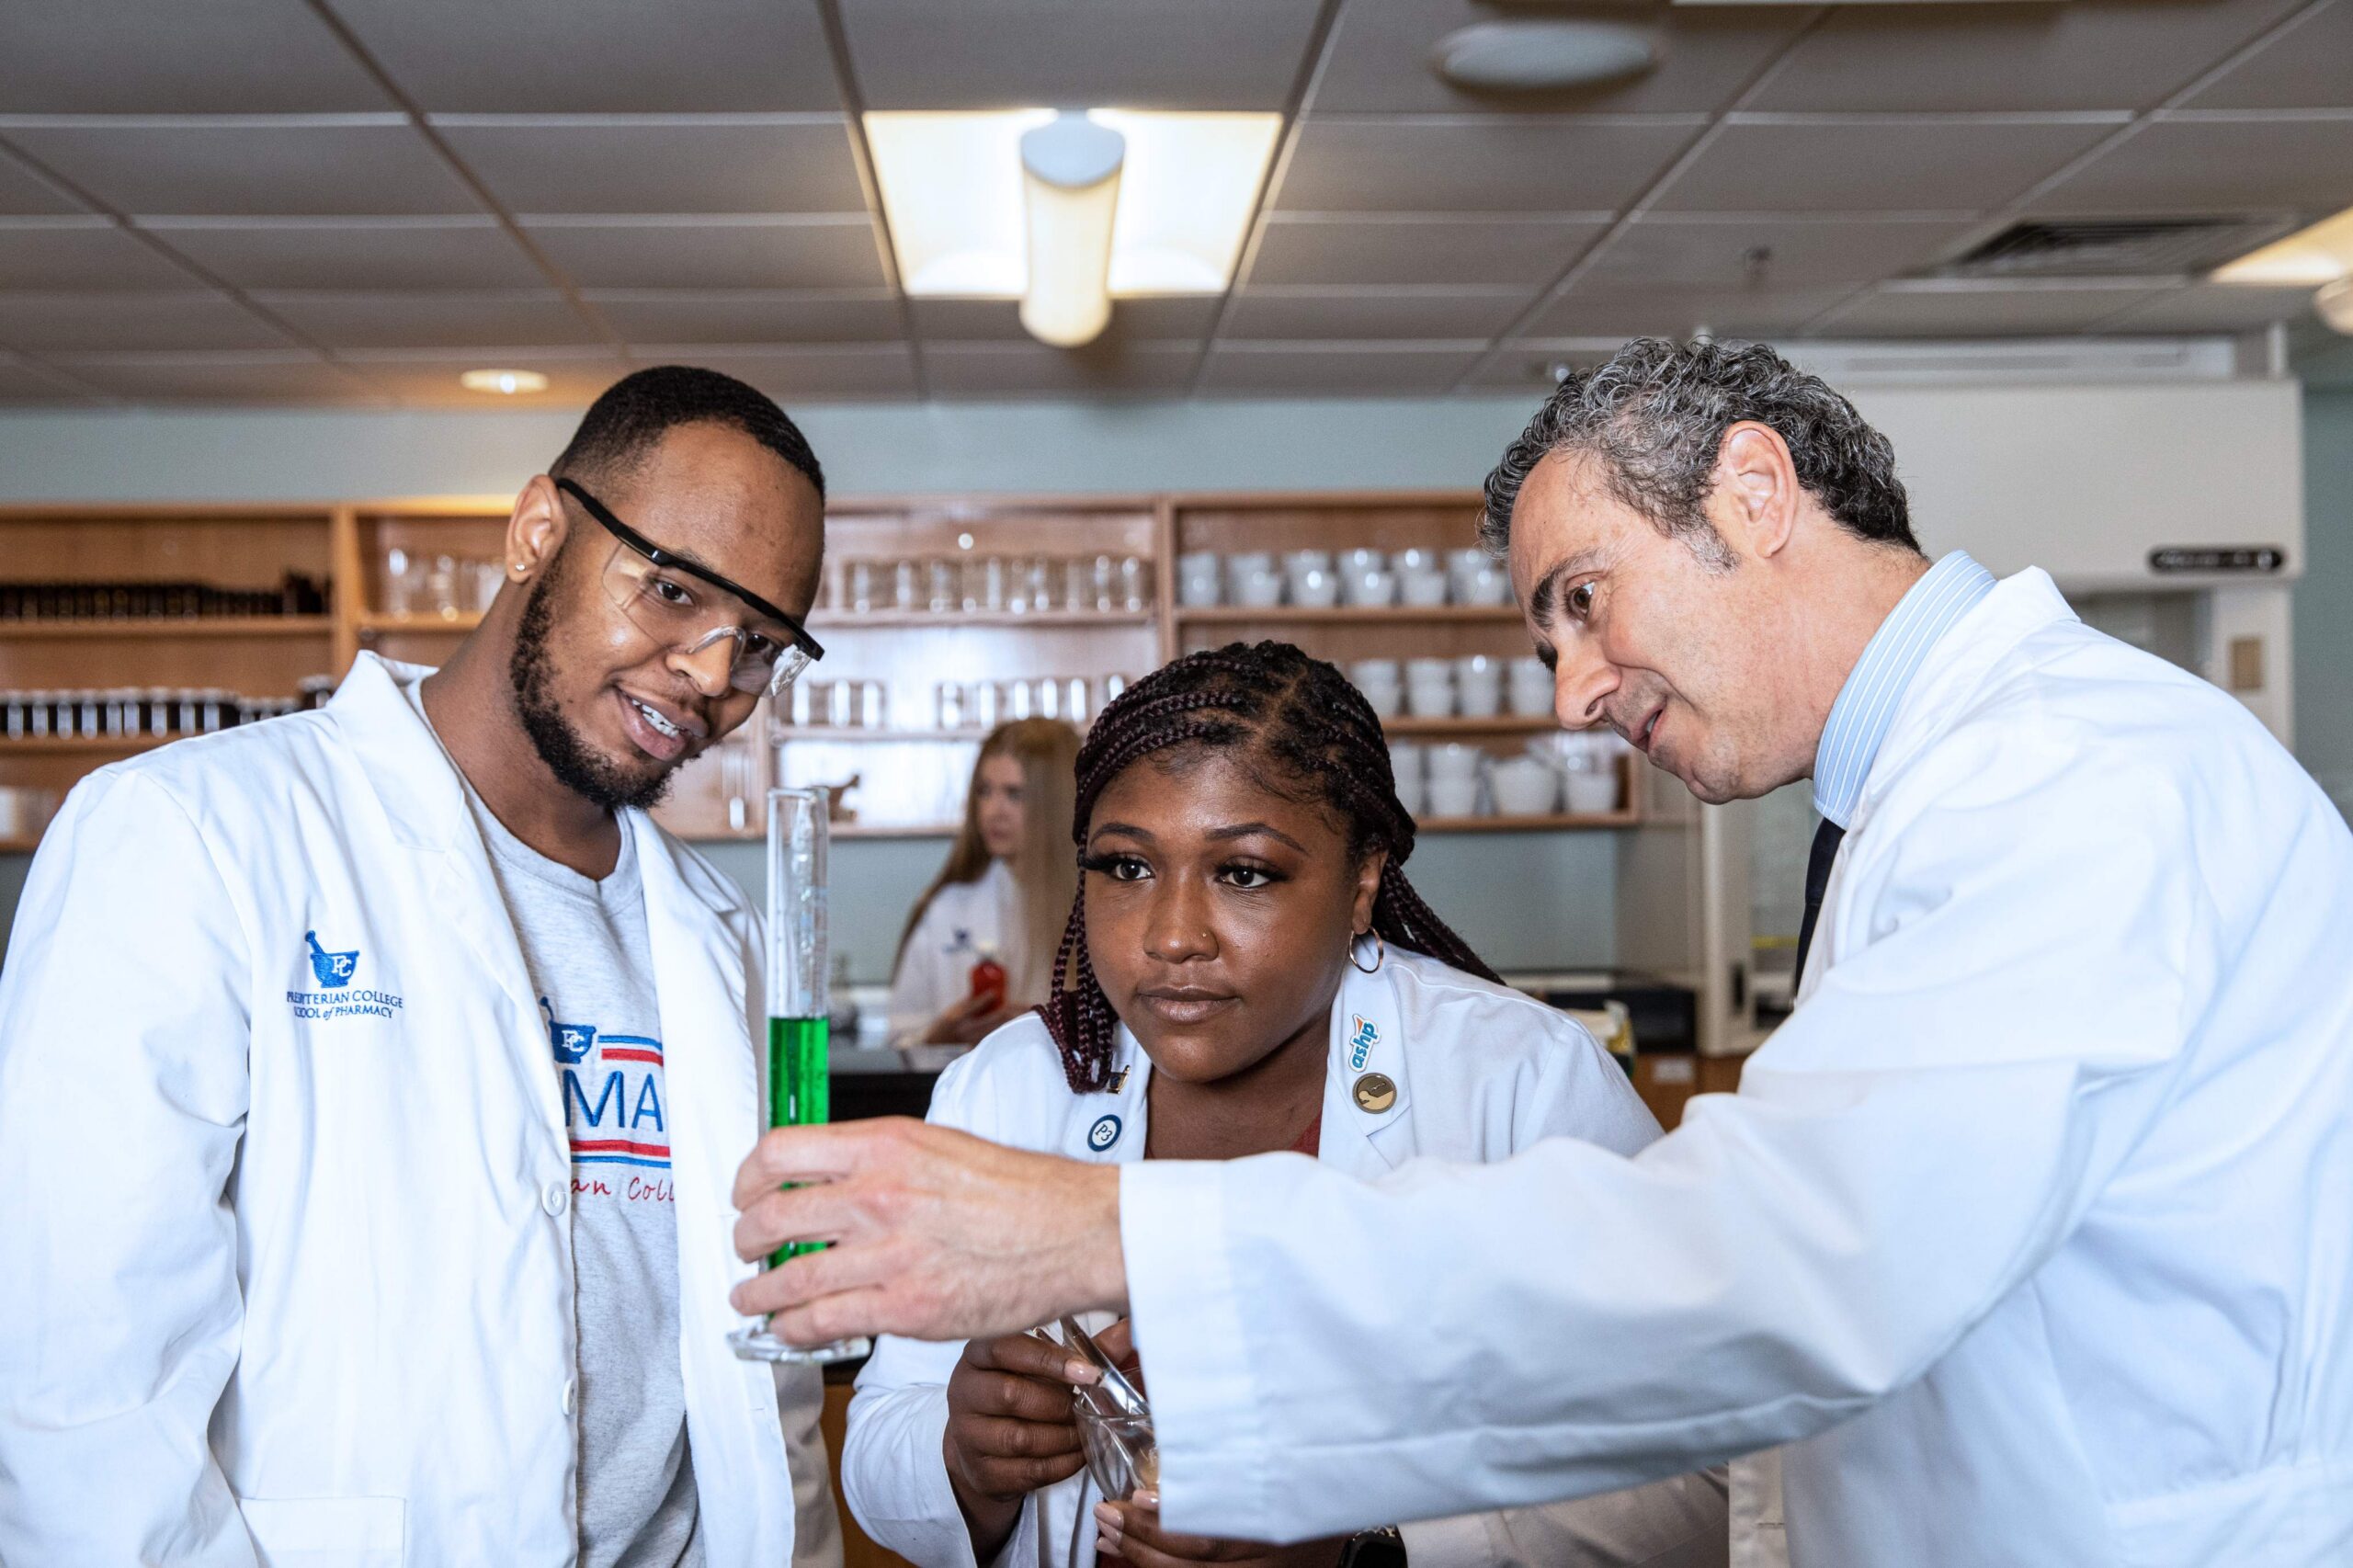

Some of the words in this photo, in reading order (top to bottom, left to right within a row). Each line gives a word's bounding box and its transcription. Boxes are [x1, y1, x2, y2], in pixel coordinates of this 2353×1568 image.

[352, 990, 404, 1008] COLLEGE
[323, 1006, 335, 1021] of
[335, 1005, 394, 1018] PHARMACY
[1352, 1022, 1378, 1068] ashp
[563, 1069, 664, 1132] MA
[1095, 1124, 1113, 1142] P3
